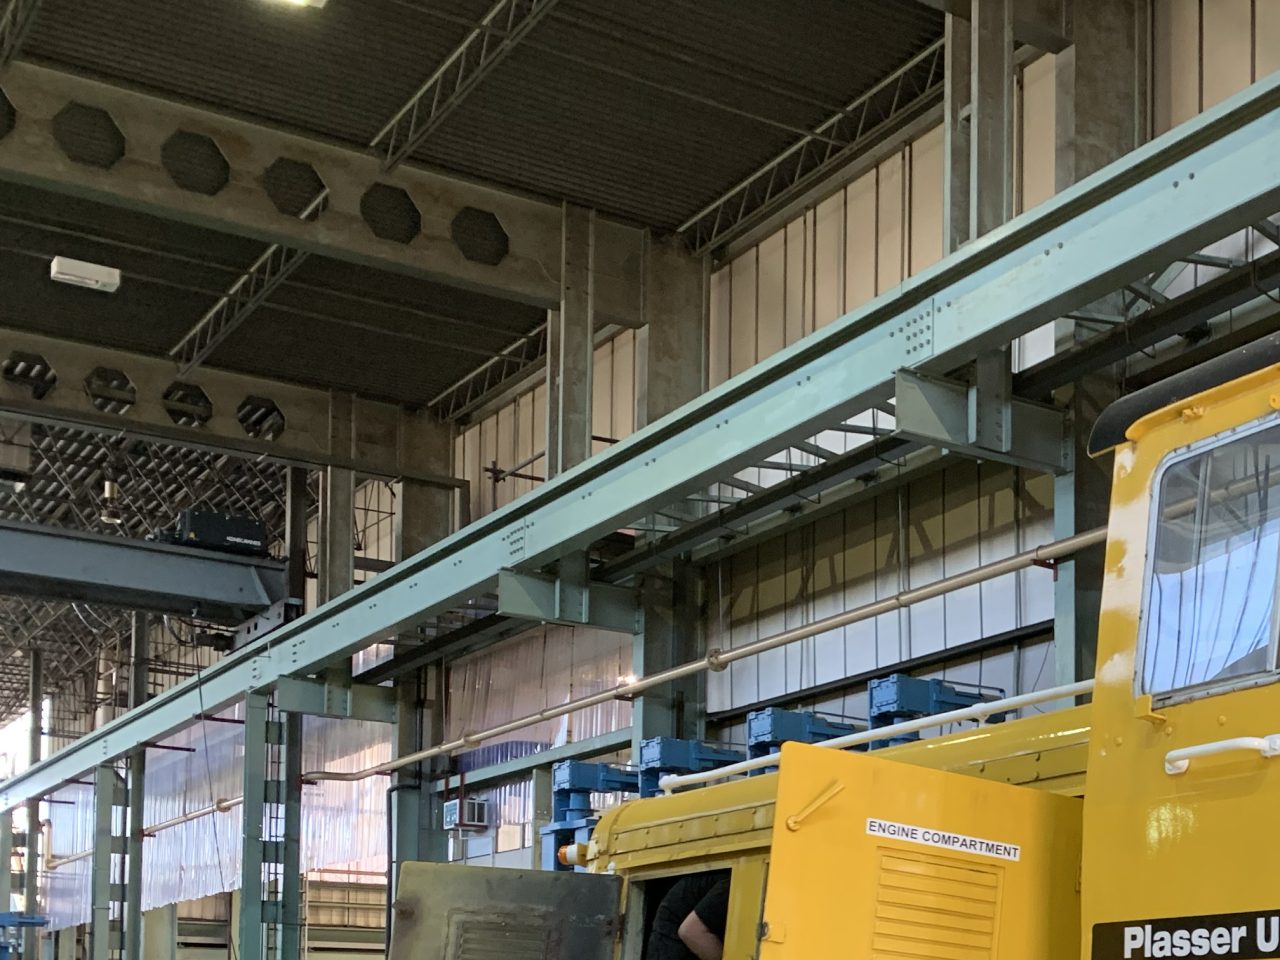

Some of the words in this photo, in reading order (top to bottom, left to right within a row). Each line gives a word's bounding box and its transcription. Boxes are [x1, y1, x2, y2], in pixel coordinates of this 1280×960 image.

[868, 820, 919, 840] ENGINE
[922, 830, 1019, 858] COMPARTMENT
[1123, 924, 1247, 959] Plasser
